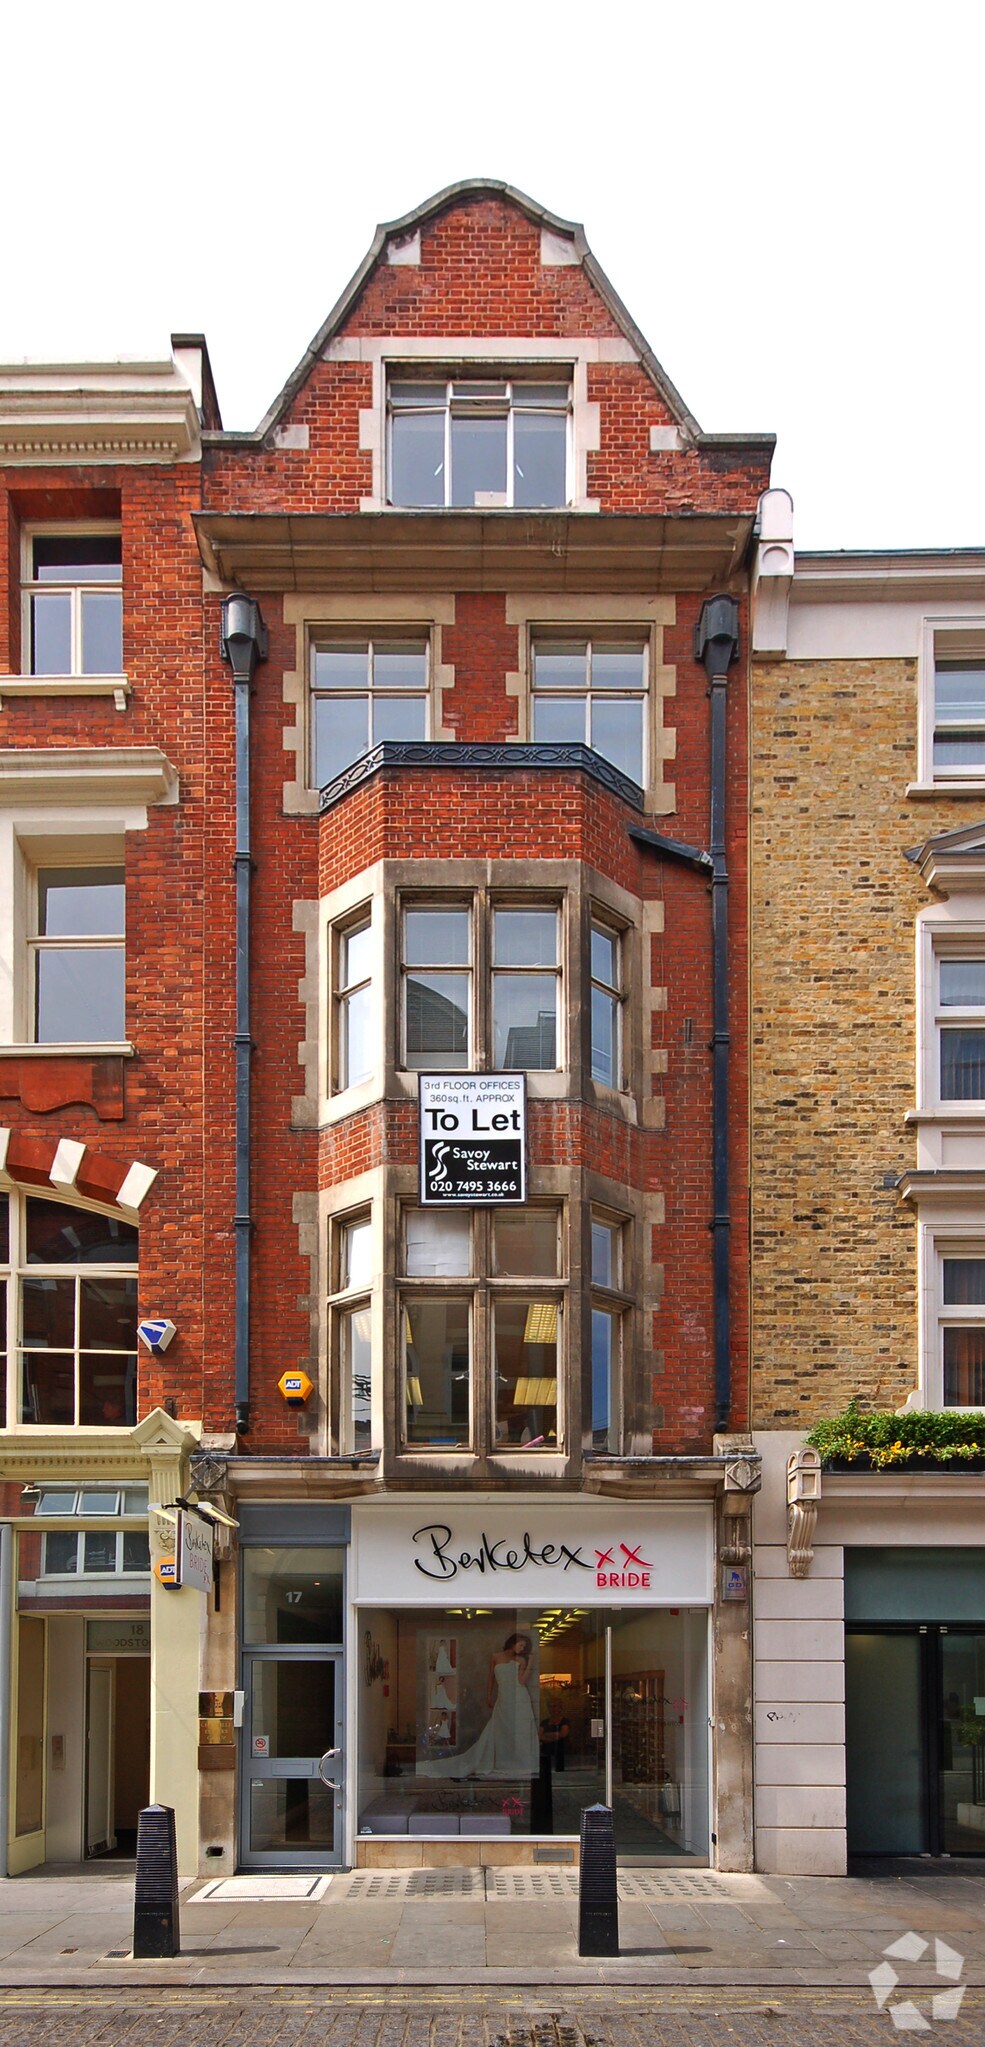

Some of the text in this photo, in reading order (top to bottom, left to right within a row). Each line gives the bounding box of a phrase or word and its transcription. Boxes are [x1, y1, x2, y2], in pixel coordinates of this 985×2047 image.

[425, 1082, 520, 1090] 3rd FLOOR OFFICES
[476, 1094, 515, 1102] APPROX
[424, 1108, 521, 1131] To Let
[452, 1147, 491, 1161] Savoy
[466, 1159, 518, 1170] Stewart
[430, 1181, 517, 1192] 020 7495 3666
[286, 1380, 301, 1388] ADT
[596, 1572, 651, 1587] BRIDE
[286, 1591, 303, 1603] 17
[131, 1624, 145, 1635] 18
